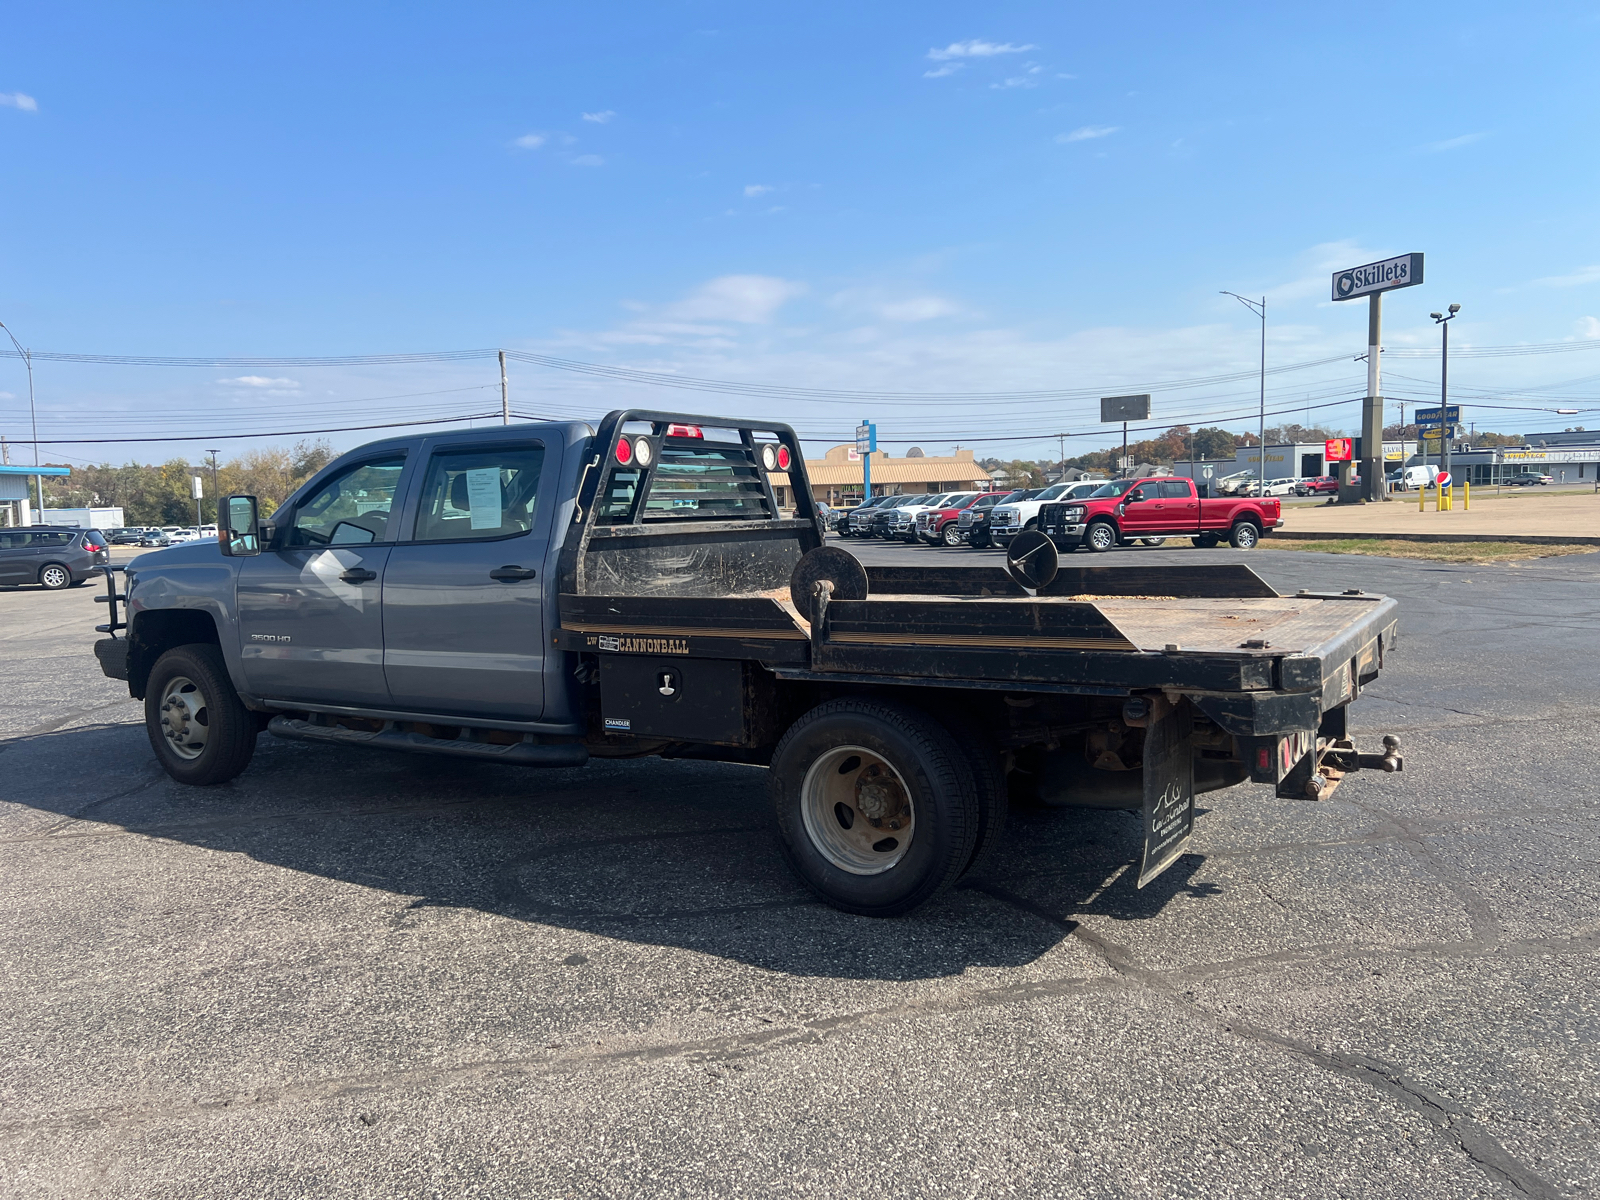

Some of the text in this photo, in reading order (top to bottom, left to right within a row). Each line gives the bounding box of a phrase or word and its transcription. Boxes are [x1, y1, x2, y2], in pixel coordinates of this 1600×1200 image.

[1355, 263, 1407, 288] Skillets
[587, 636, 598, 645] LW
[619, 637, 689, 654] CANNONBALL
